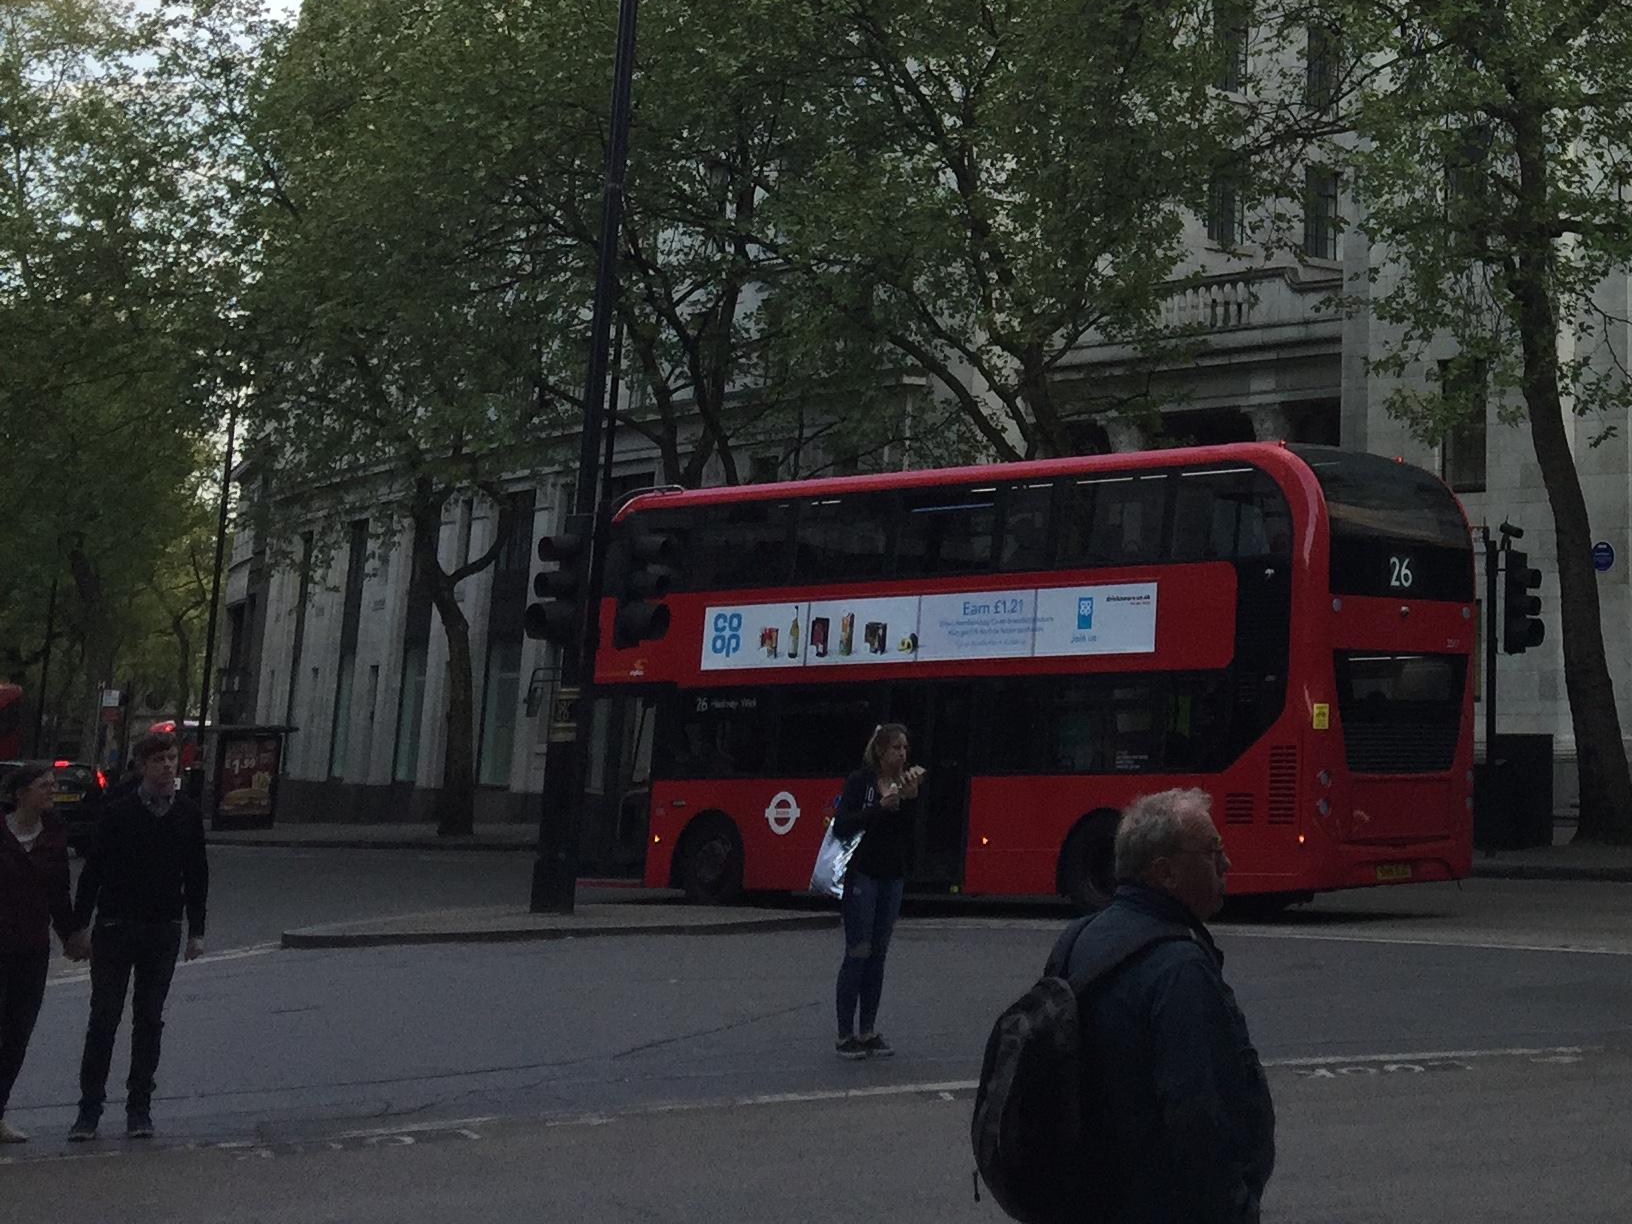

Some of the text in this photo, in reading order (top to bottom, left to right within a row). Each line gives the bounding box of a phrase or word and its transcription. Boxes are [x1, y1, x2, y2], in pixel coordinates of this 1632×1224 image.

[1389, 556, 1413, 587] 26
[962, 599, 1024, 616] Earn £1.21
[696, 696, 709, 712] 26
